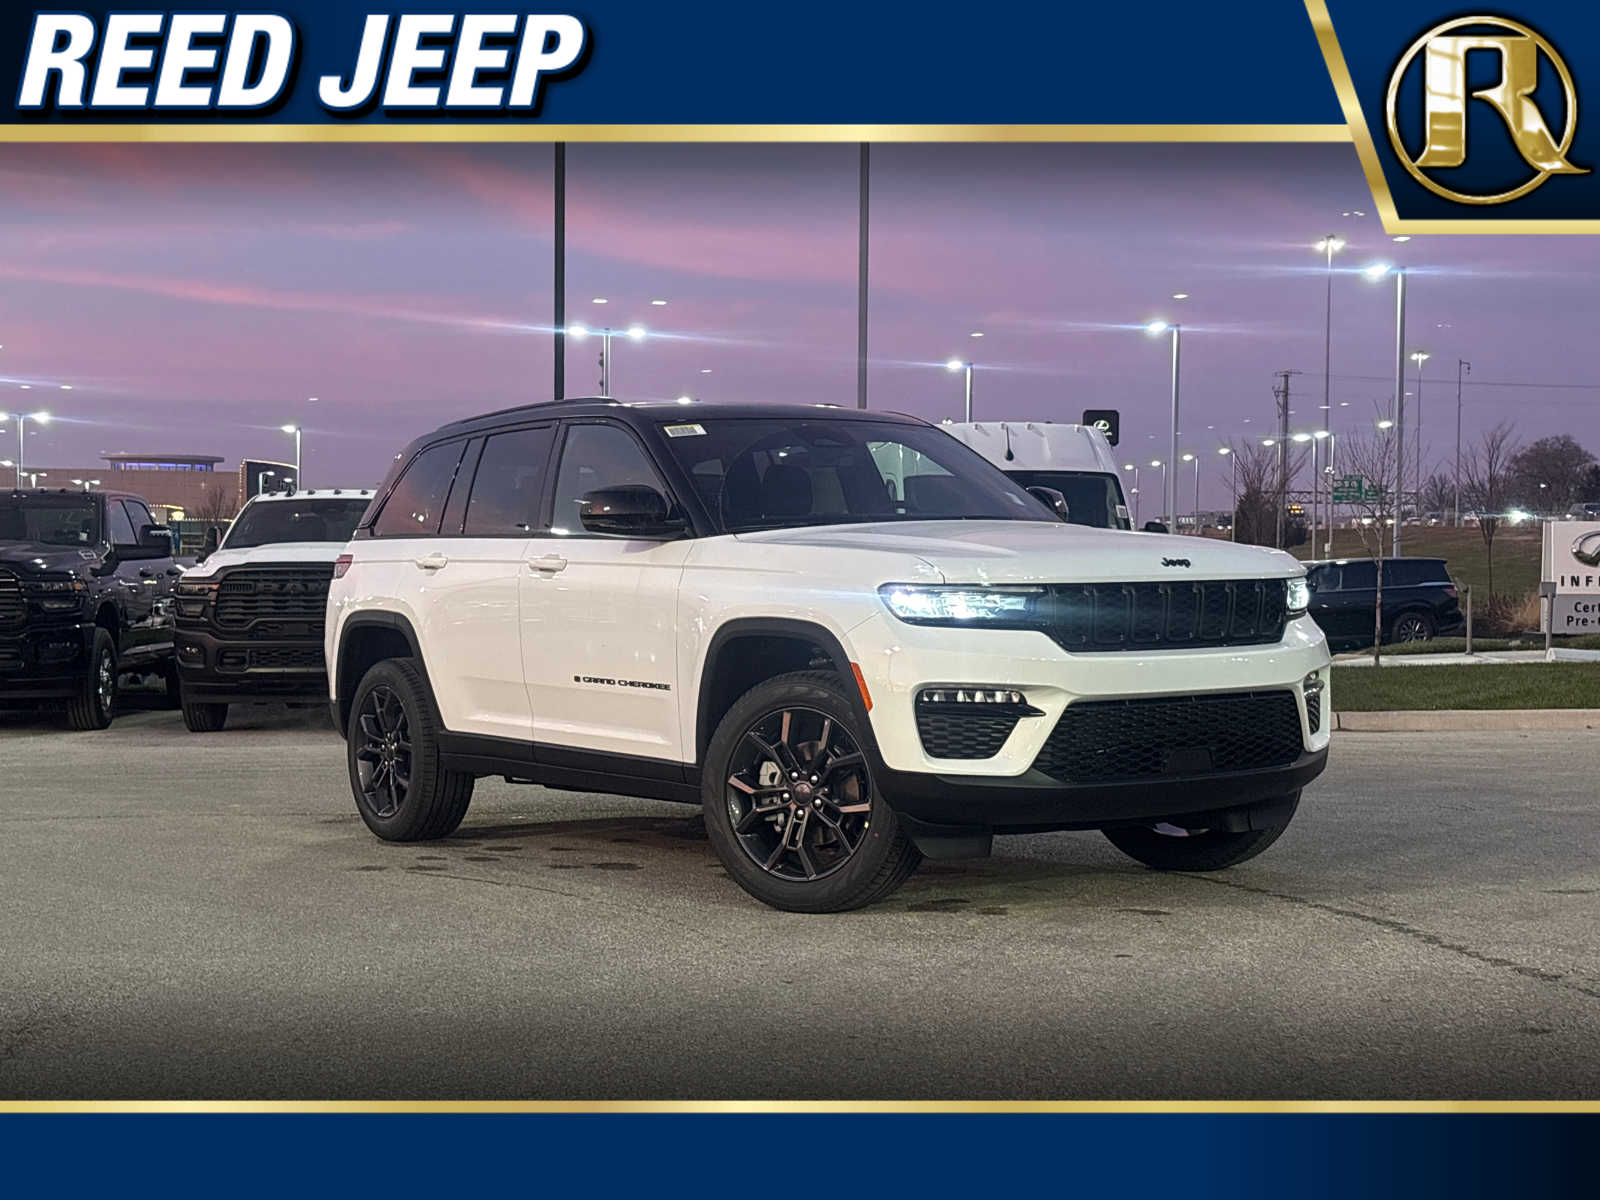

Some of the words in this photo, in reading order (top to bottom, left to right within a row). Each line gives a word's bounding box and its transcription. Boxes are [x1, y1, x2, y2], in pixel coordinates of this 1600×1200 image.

[1160, 557, 1191, 568] Jeep
[1566, 616, 1600, 627] Pre-
[618, 679, 671, 690] CHEROKEE
